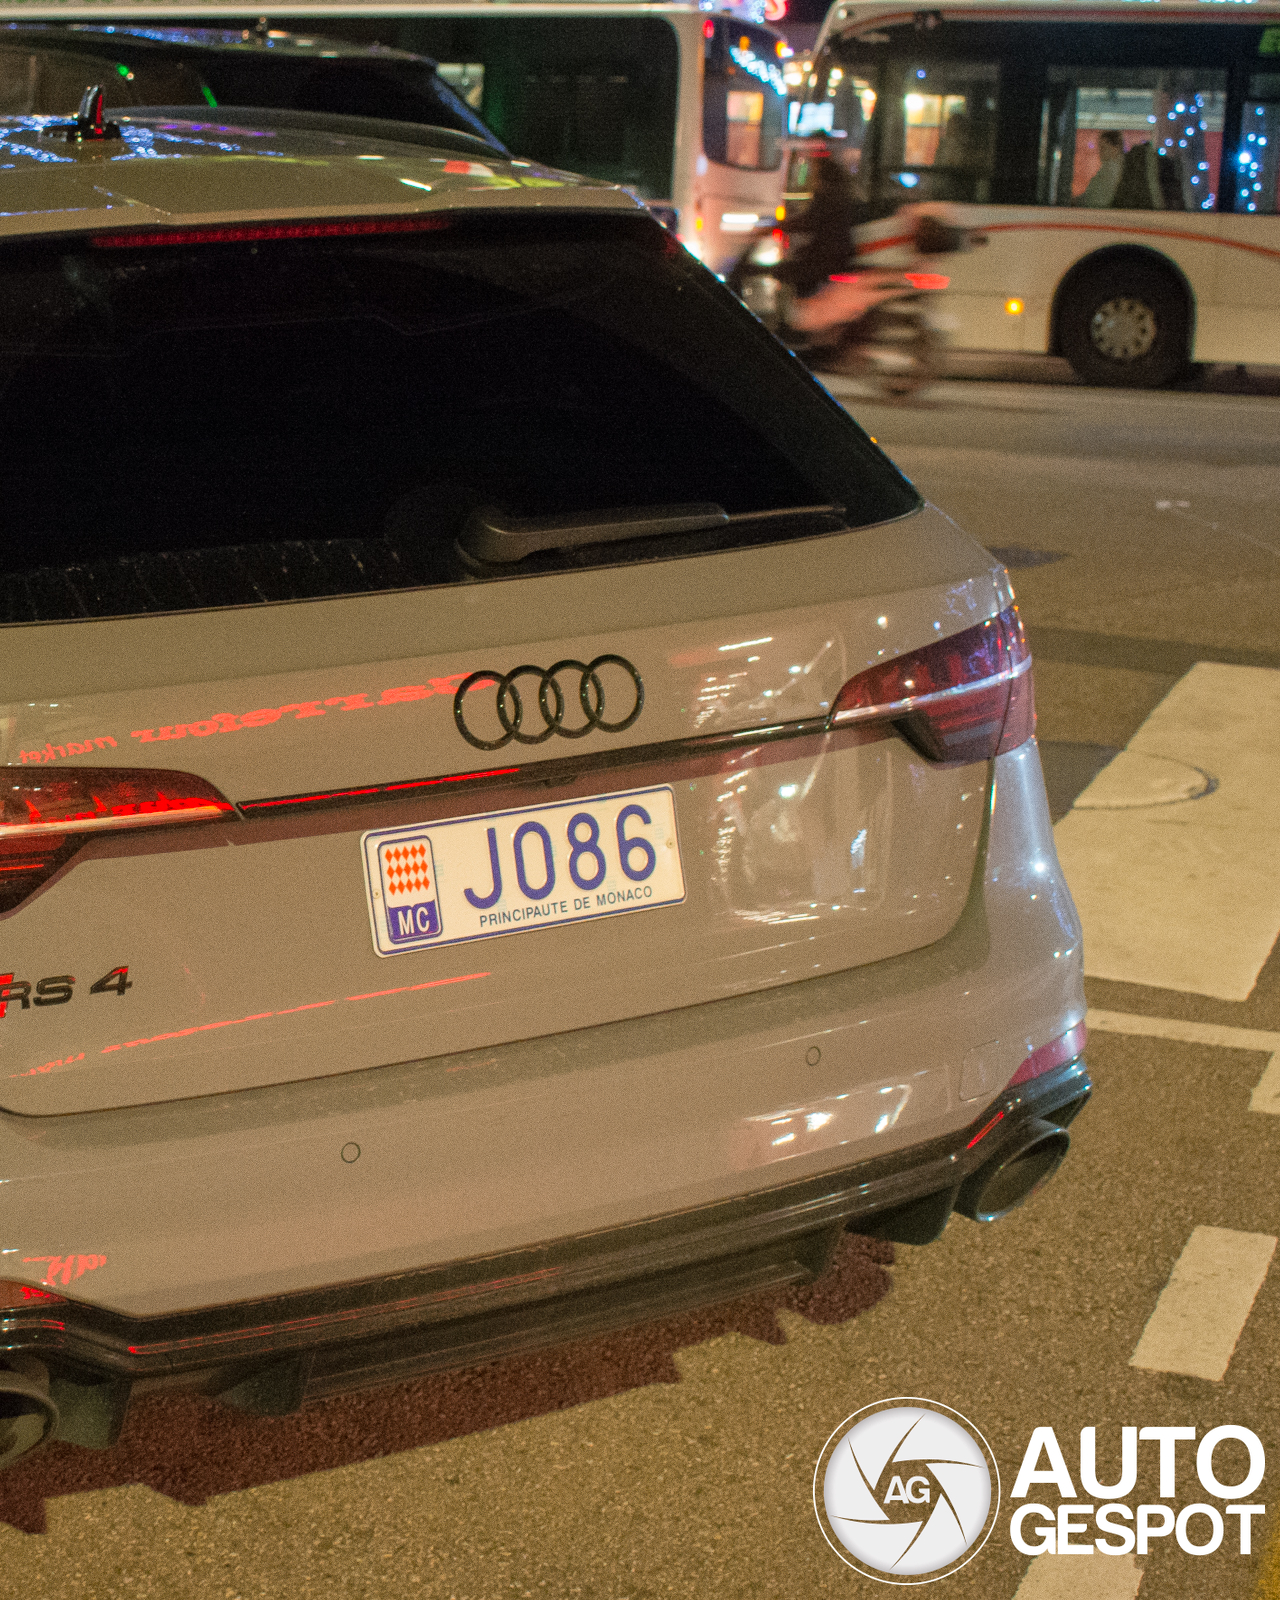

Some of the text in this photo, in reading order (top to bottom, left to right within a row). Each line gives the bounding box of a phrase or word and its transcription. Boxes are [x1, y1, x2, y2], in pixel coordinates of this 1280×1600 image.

[464, 804, 656, 909] J086
[397, 906, 431, 936] MC
[479, 885, 653, 927] PRINCIPAUTE DE MONACO
[90, 966, 133, 996] 4
